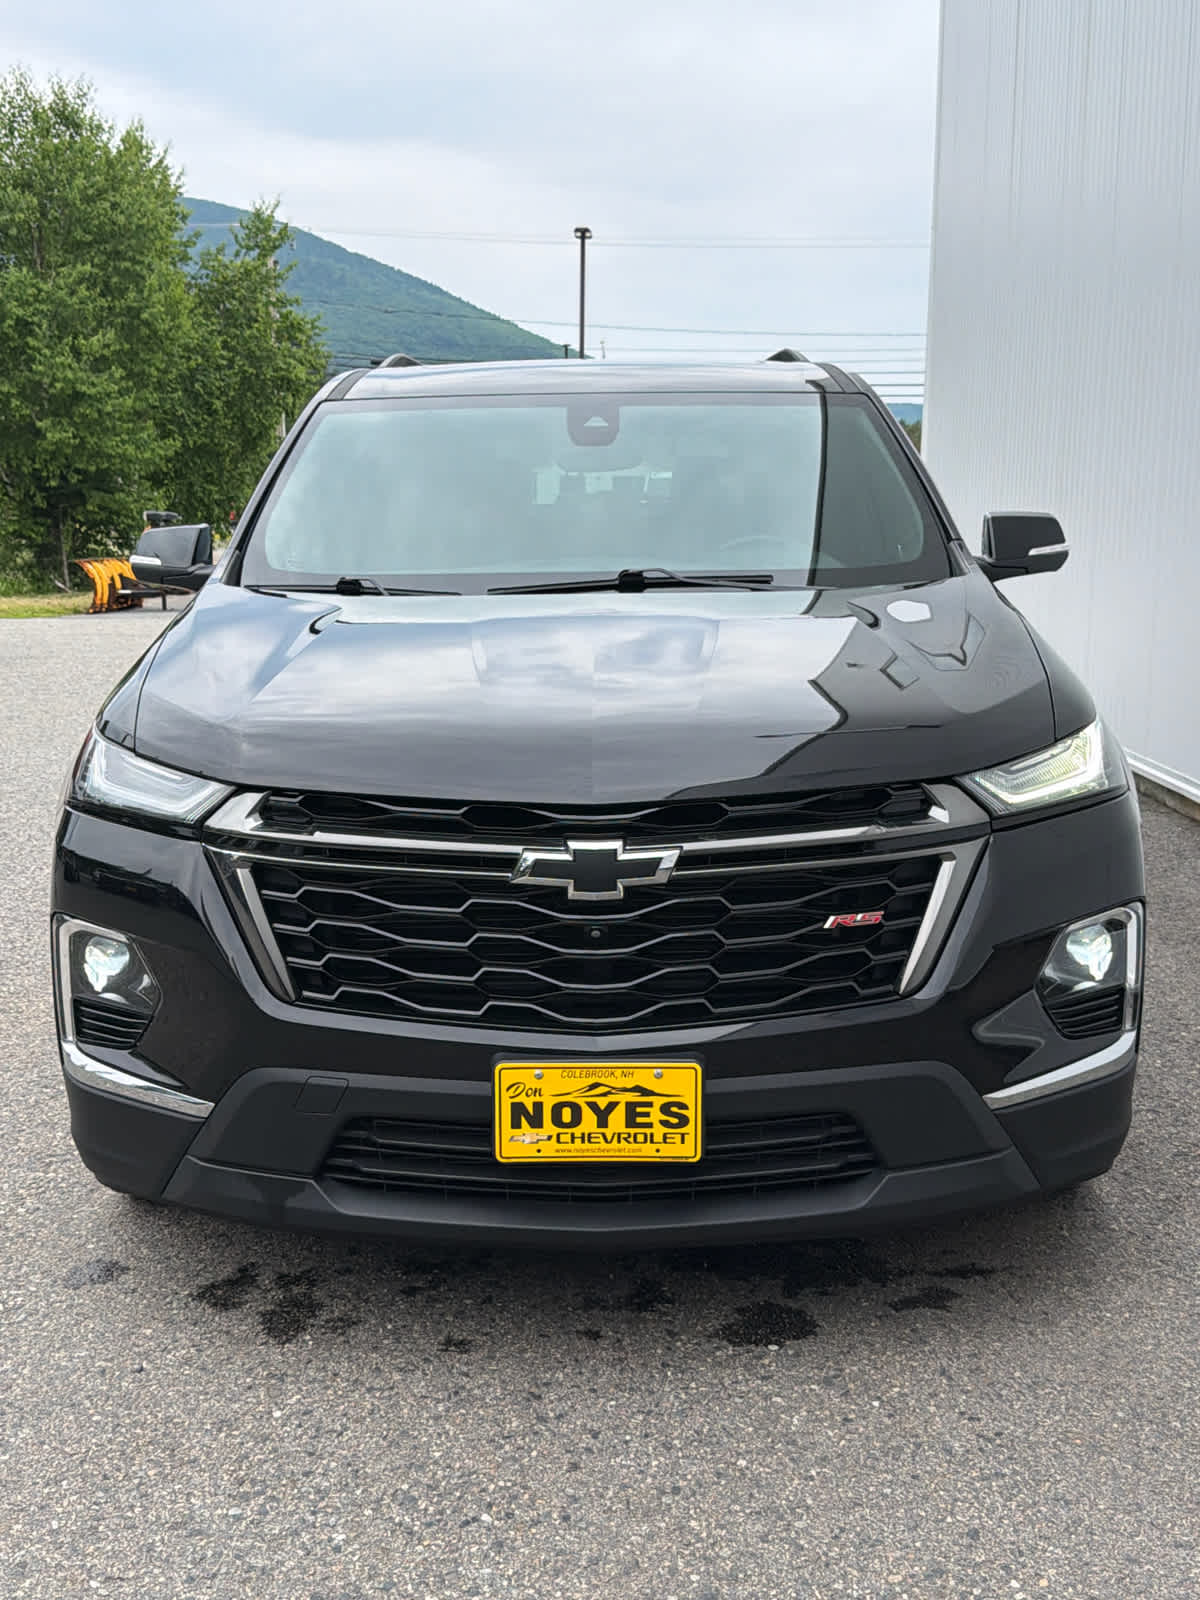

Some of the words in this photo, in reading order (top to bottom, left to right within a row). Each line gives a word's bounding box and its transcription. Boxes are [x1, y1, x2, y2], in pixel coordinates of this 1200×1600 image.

[823, 911, 884, 929] RS
[560, 1070, 618, 1079] COLEBROOK,
[620, 1070, 634, 1078] NH
[506, 1082, 543, 1099] Don
[510, 1101, 690, 1130] NOYES
[556, 1132, 690, 1145] CHEVROLET
